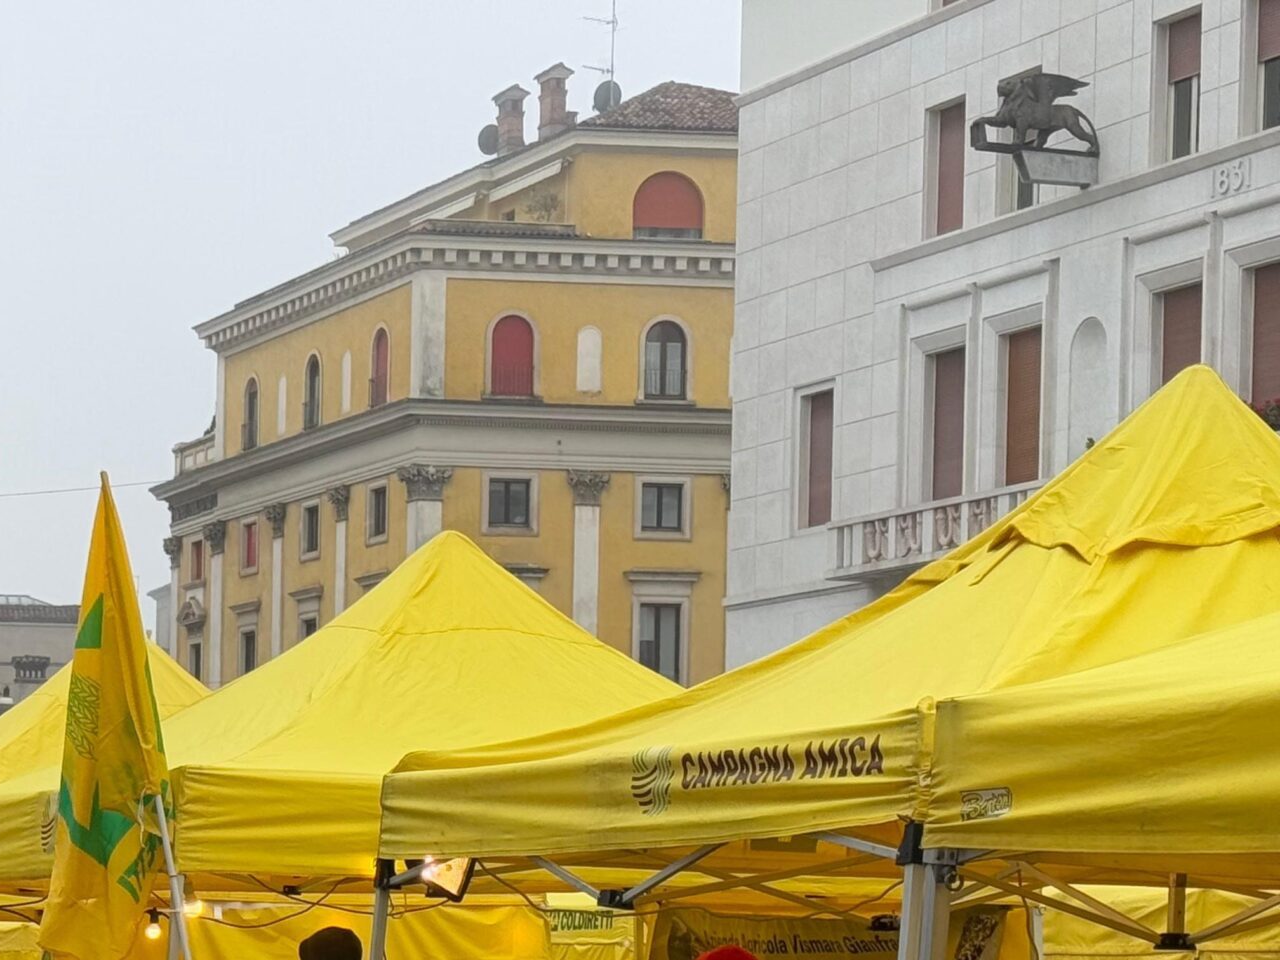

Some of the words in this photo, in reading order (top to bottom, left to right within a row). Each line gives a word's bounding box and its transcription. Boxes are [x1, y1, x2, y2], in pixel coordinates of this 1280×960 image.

[681, 744, 794, 790] CAMPAGNA
[799, 733, 885, 780] AMICA
[792, 934, 841, 954] Vismara
[843, 935, 898, 954] Gianfra
